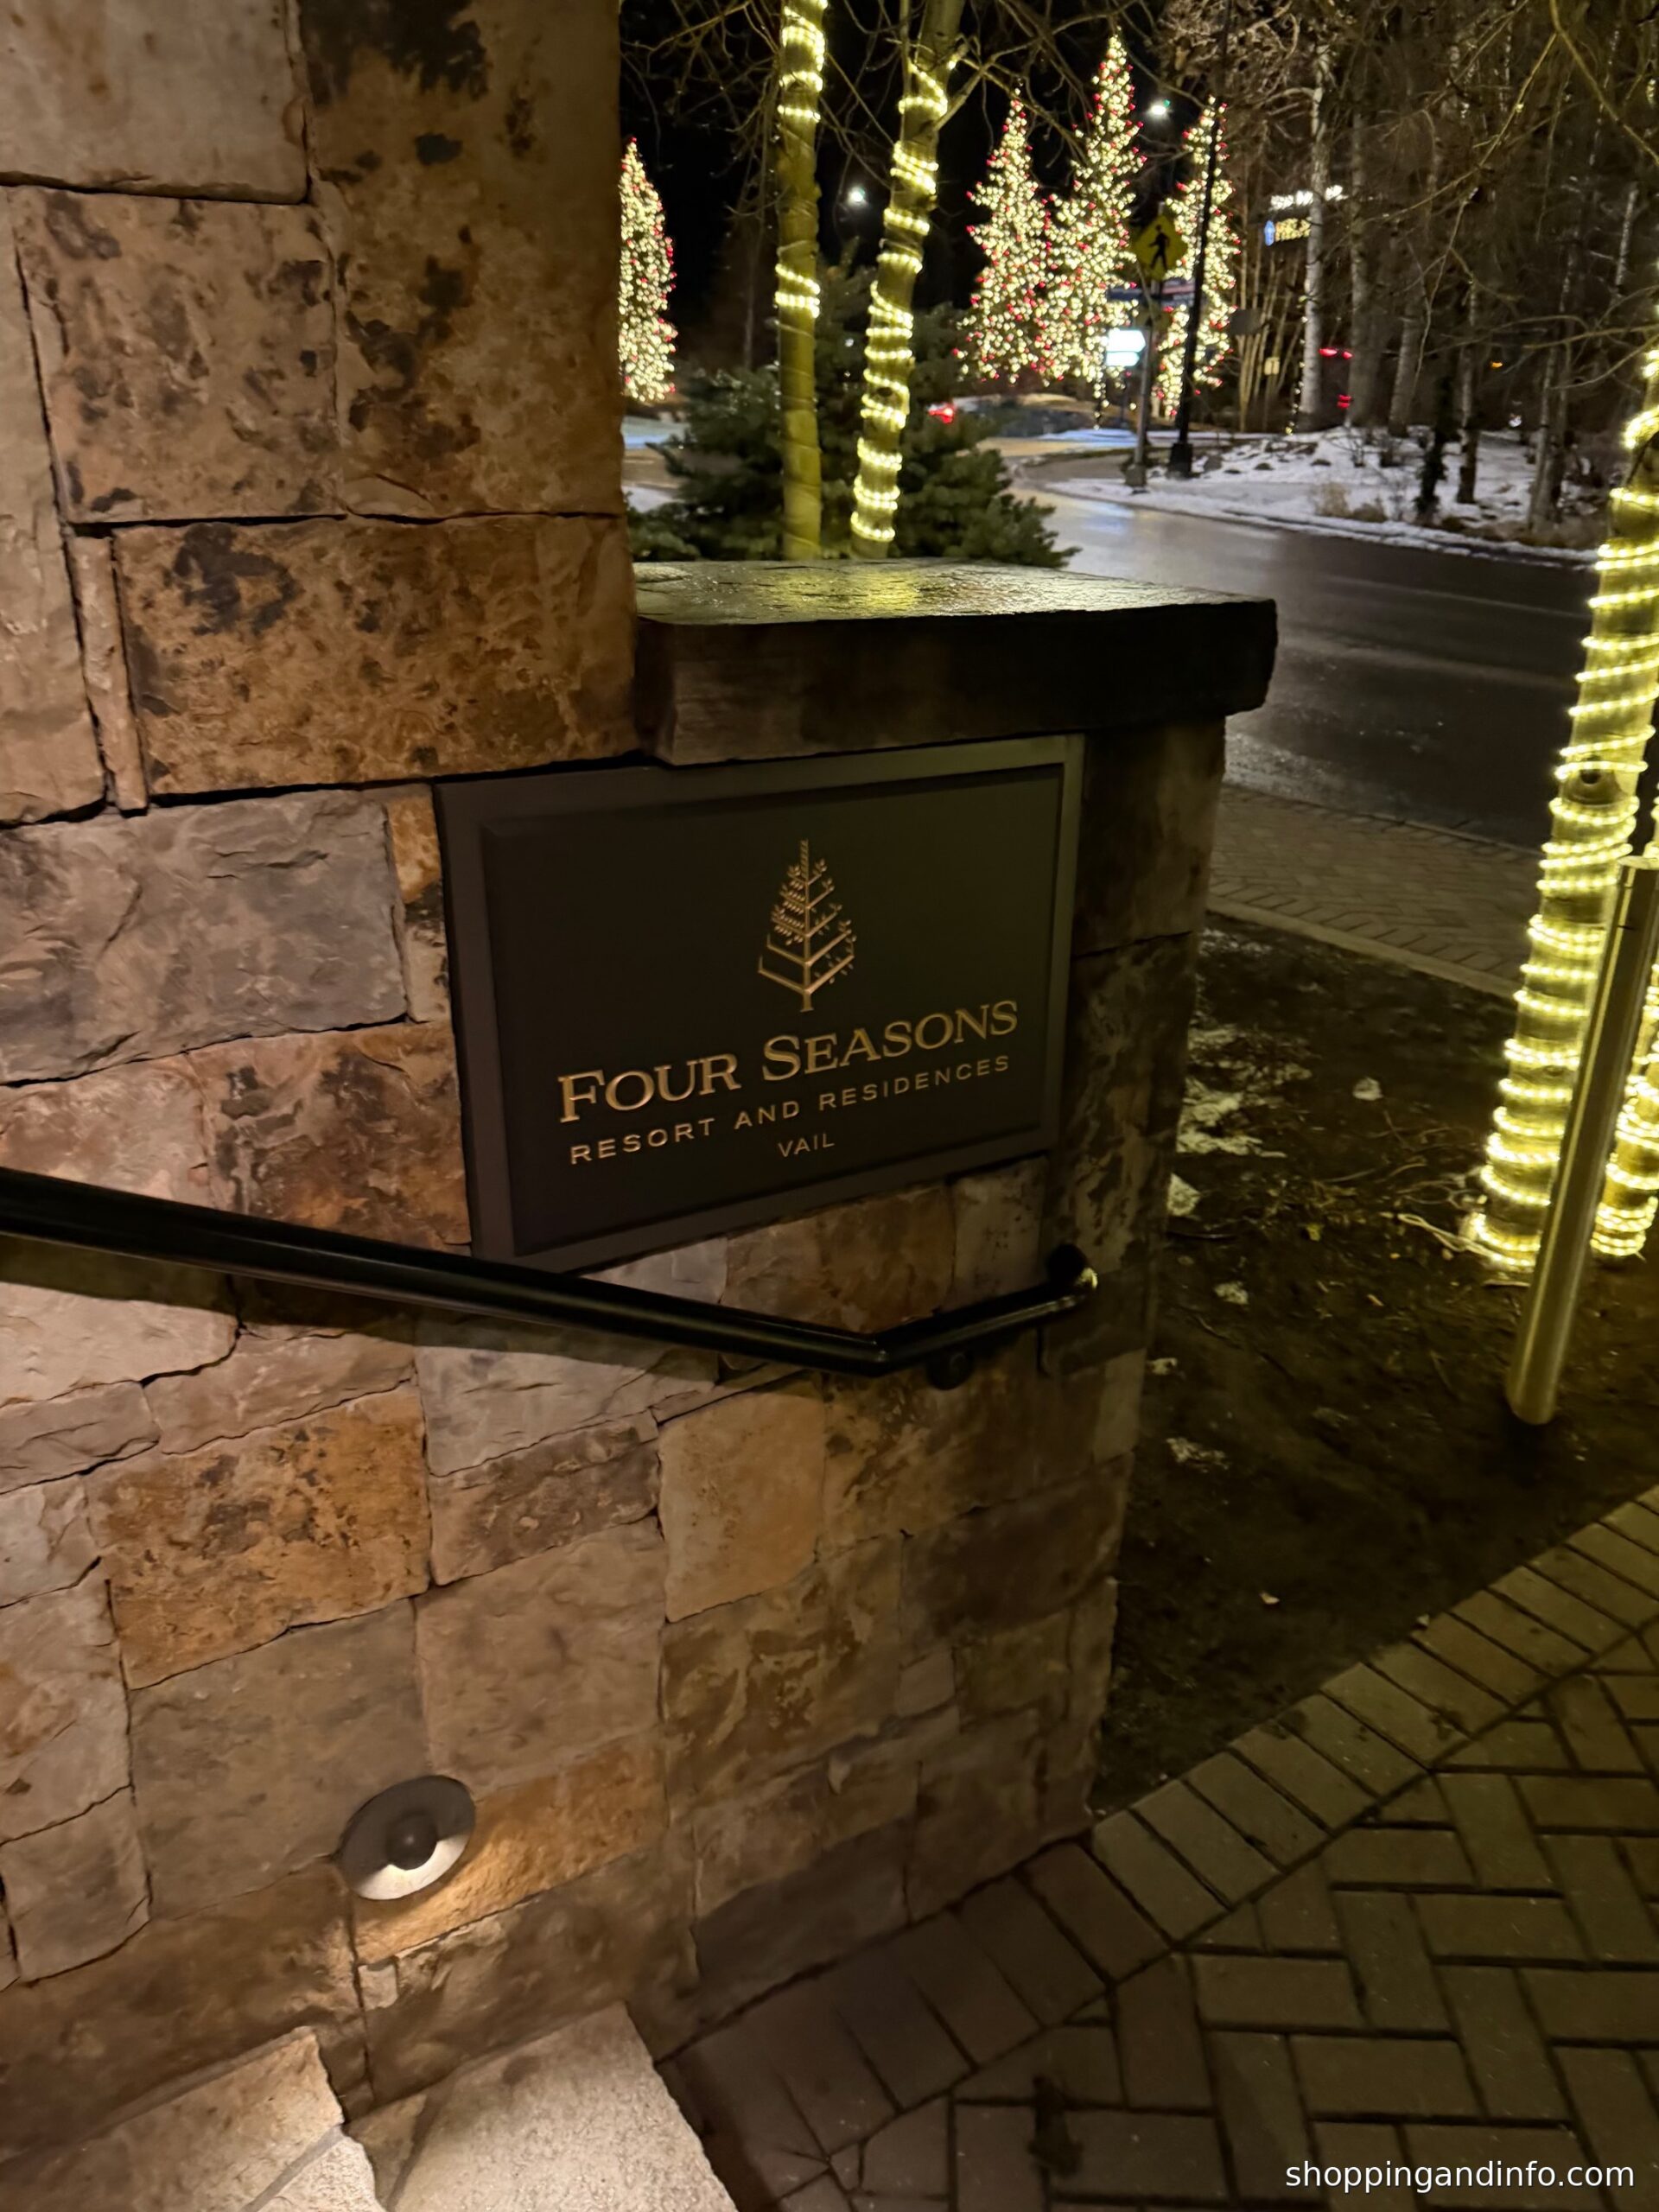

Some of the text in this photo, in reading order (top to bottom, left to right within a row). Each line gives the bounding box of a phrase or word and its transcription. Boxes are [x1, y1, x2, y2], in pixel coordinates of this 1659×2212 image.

[558, 1001, 1019, 1123] FOUR SEASONS
[571, 1056, 1010, 1165] RESORT AND RESIDENCES
[778, 1134, 836, 1158] VAIL
